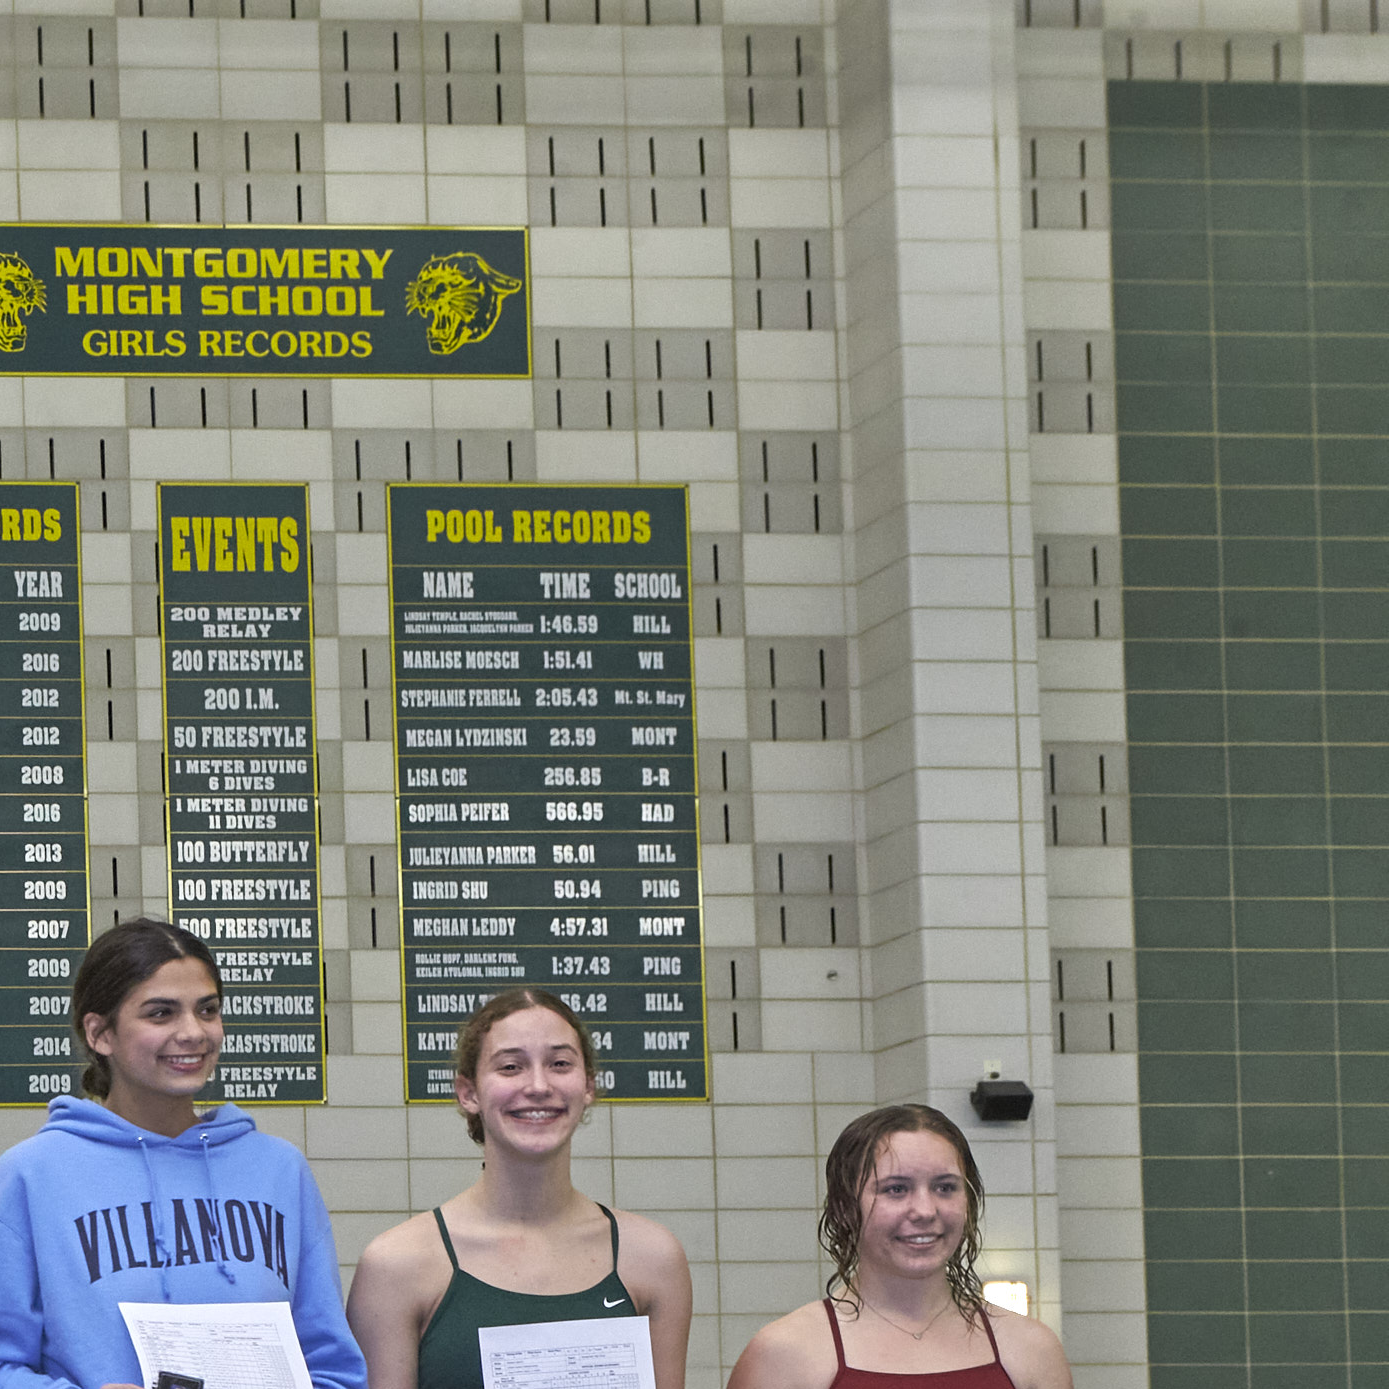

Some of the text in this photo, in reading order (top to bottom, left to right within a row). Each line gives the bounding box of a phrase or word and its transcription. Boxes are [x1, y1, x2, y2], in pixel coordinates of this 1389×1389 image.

[55, 247, 391, 278] MONTGOMERY
[67, 284, 384, 316] HIGH SCHOOL
[83, 330, 372, 358] GIRLS RECORDS
[427, 510, 651, 543] POOL RECORDS
[171, 517, 299, 572] EVENTS
[14, 571, 62, 597] YEAR
[423, 571, 681, 598] NAME TIME SCHOOL
[171, 607, 301, 621] 200 MEDLEY
[203, 624, 271, 638] RELAY
[172, 650, 304, 671] 200 FREESTYLE
[403, 651, 663, 669] MARLISE MOESCH 1:51.41 WH
[22, 689, 58, 707] 2012
[23, 727, 59, 745] 2012
[176, 798, 307, 812] 1 METER DIVING
[409, 802, 674, 822] SOPHIA PEIFER 566.95 HAD
[209, 815, 276, 829] 11 DIVES
[177, 841, 309, 862] 100 BUTTERFLY
[28, 920, 69, 938] 2007
[414, 918, 685, 936] MEGHAN LEDDY 4:57.31 MONT
[74, 1198, 289, 1291] VILLANOVA
